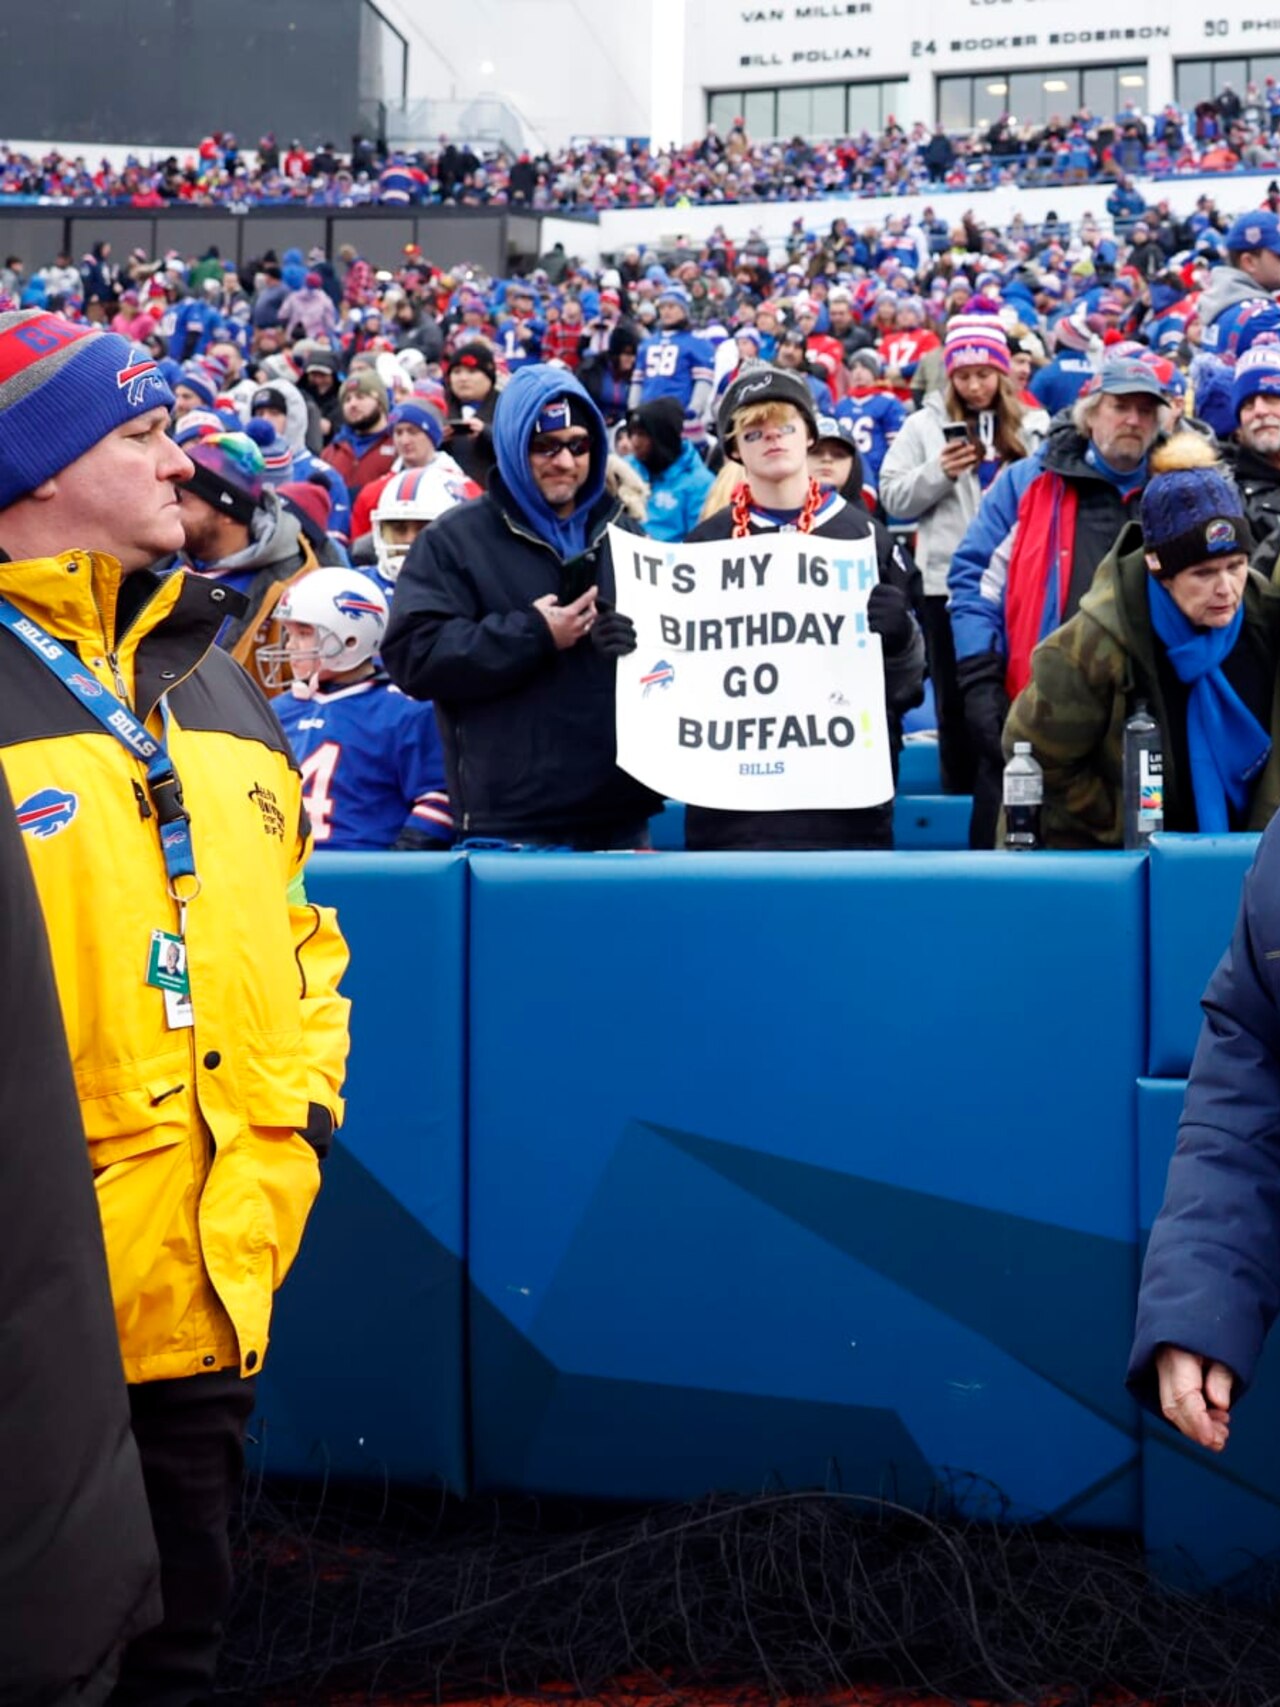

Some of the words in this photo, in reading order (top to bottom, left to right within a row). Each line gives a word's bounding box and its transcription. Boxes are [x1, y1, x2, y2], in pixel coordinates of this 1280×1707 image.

[741, 10, 784, 22] VAN
[796, 3, 871, 18] MILLER
[740, 54, 782, 67] BILL
[793, 47, 871, 62] POLIAN
[911, 40, 936, 57] 24
[951, 35, 1037, 52] BOOKER
[646, 344, 679, 377] 58
[888, 341, 917, 368] 17
[633, 551, 696, 594] IT'S
[721, 553, 772, 591] MY
[797, 551, 876, 591] 16TH
[11, 618, 64, 660] BILLS
[722, 662, 779, 698] GO
[106, 708, 158, 758] BILLS
[738, 761, 785, 776] BILLS
